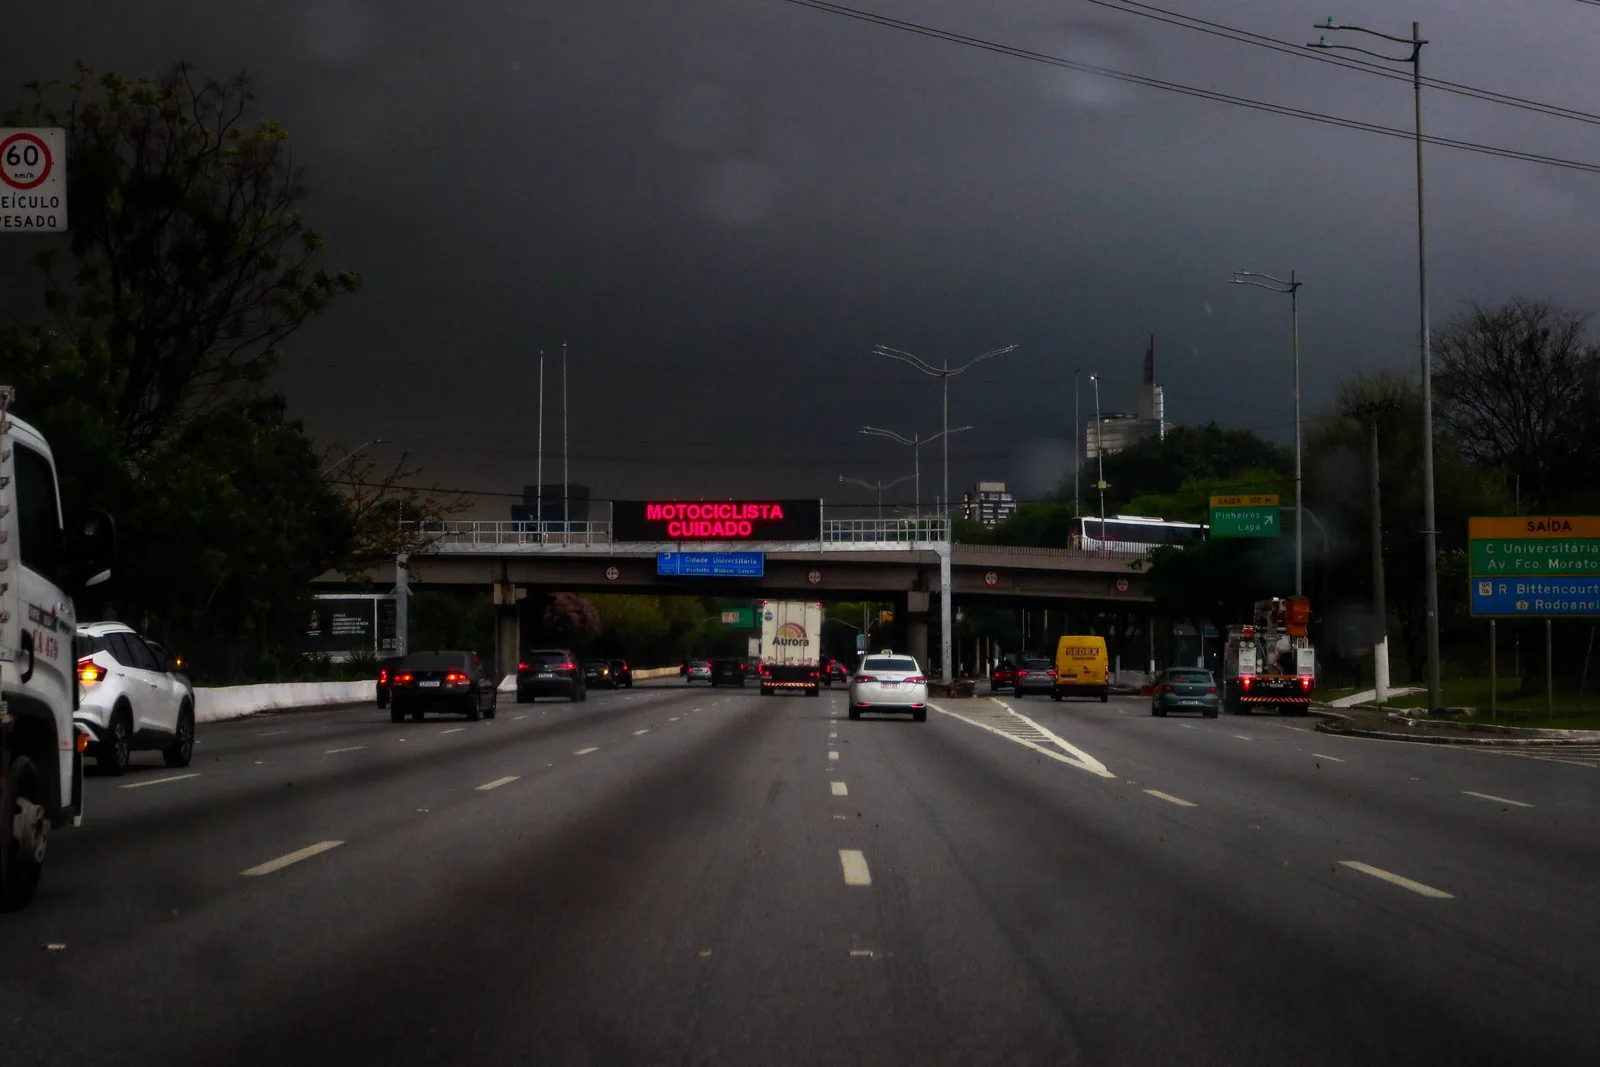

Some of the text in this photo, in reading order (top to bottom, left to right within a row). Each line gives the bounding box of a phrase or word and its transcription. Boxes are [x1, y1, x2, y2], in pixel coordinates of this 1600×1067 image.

[7, 145, 38, 165] 60
[0, 215, 56, 228] ESADO
[646, 503, 784, 520] MOTOCICLISTA
[1215, 511, 1261, 520] Pinheiros
[667, 520, 753, 538] CUIDADO
[1238, 523, 1261, 532] Lapa
[1527, 517, 1572, 532] SAÍDA
[1503, 542, 1599, 554] Universitária
[684, 556, 757, 565] Cidade Universitária
[1548, 558, 1598, 569] Morato
[1516, 583, 1599, 594] Bittencourt
[1535, 599, 1599, 610] Rodoanel
[772, 636, 810, 647] Aurora
[1066, 647, 1098, 656] SEDEX
